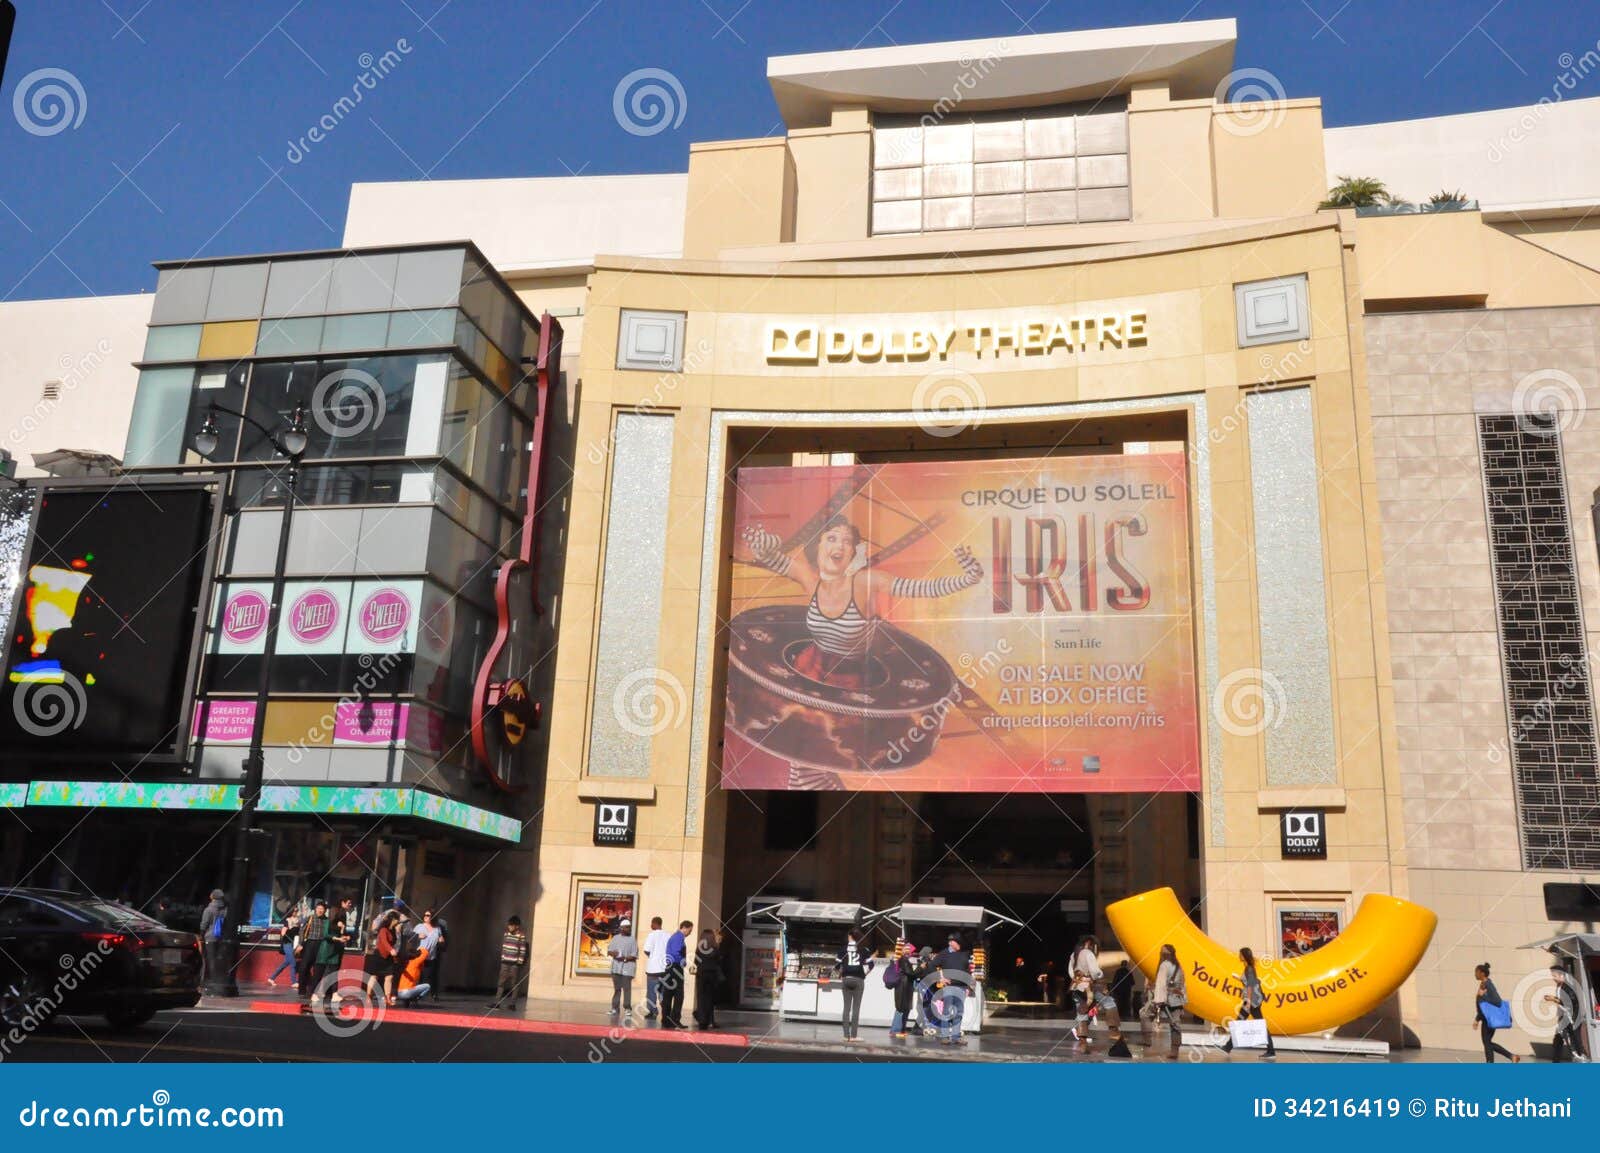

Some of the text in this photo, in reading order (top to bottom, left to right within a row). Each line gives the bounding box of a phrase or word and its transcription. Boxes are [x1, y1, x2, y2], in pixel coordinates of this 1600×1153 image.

[824, 311, 1149, 363] DOLBY THEATRE
[961, 483, 1176, 510] CIRQUE DU SOLEIL
[991, 510, 1152, 614] IRIS
[1054, 638, 1102, 649] Sun Life
[1000, 663, 1146, 683] ON SALE NOW
[999, 685, 1147, 705] AT BOX OFFICE
[212, 707, 249, 715] GREATEST
[208, 717, 229, 725] ANDY
[982, 713, 1166, 730] cirquedusoleil.com/iris
[208, 726, 248, 735] ON EARTH
[598, 826, 628, 836] DOLBY
[1286, 838, 1320, 847] DOLBY
[847, 951, 861, 966] 12
[1191, 960, 1219, 989] You
[1274, 988, 1310, 1008] you
[1309, 976, 1348, 999] love
[1347, 967, 1368, 984] it.
